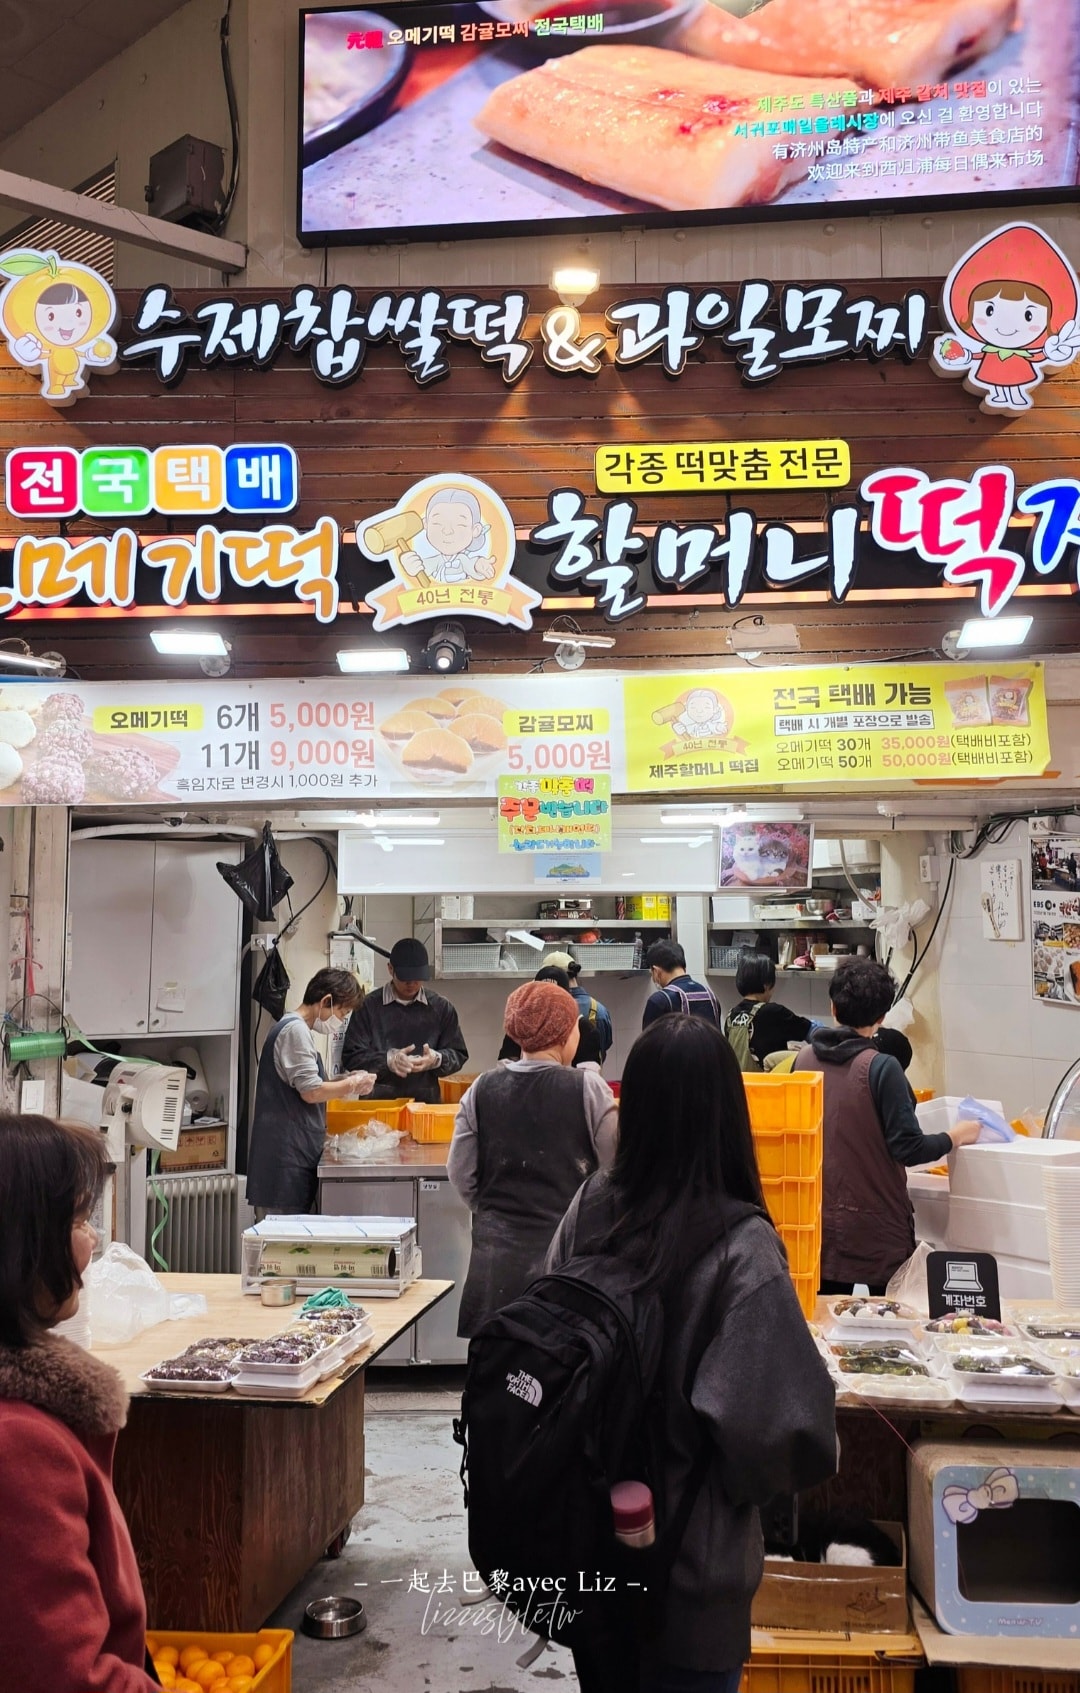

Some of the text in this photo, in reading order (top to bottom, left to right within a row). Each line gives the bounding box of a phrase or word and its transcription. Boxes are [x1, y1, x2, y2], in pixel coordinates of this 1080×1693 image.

[387, 24, 456, 46] 오메기떡
[460, 20, 530, 43] 감귤모찌
[534, 13, 604, 36] 전국택배
[757, 94, 806, 113] 제주도
[809, 88, 875, 109] 특산품과
[878, 86, 912, 105] 제주
[1008, 77, 1043, 95] 있는
[900, 108, 933, 126] 오신
[937, 106, 954, 124] 걸
[958, 100, 1043, 122] 환영합니다
[772, 124, 1044, 160] 有济州岛特产和济州带鱼美食店的
[807, 149, 1045, 181] 欢迎来到西归浦每日偶来市场
[121, 280, 926, 383] 수제찹쌀떡 & 과일모찌
[604, 445, 844, 484] 각종 떡맞춤 전문
[17, 451, 284, 507] 전국택배
[532, 490, 860, 614] 할머니
[0, 519, 338, 622] 메기떡
[416, 585, 495, 606] 40년 전통
[773, 682, 932, 710] 전국 택배 가능
[110, 701, 376, 732] 오메기떡 6개 5,000원
[518, 714, 594, 733] 감귤모찌
[778, 713, 932, 732] 택배 시 개별 포장으로 발송
[201, 738, 376, 770] 11개 9,000원
[508, 740, 612, 774] 5,000원
[683, 740, 703, 750] 40년
[776, 738, 832, 755] 오메기떡
[836, 737, 871, 752] 30개
[649, 758, 760, 779] 제주할머니 떡집
[777, 755, 834, 771] 오메기떡
[838, 754, 872, 769] 50개
[176, 773, 378, 792] 흑임자로 변경시 1,000원 추가
[941, 1293, 987, 1307] 계좌번호
[505, 1372, 531, 1392] NORTH
[517, 1369, 534, 1384] THE
[506, 1383, 528, 1400] FACE
